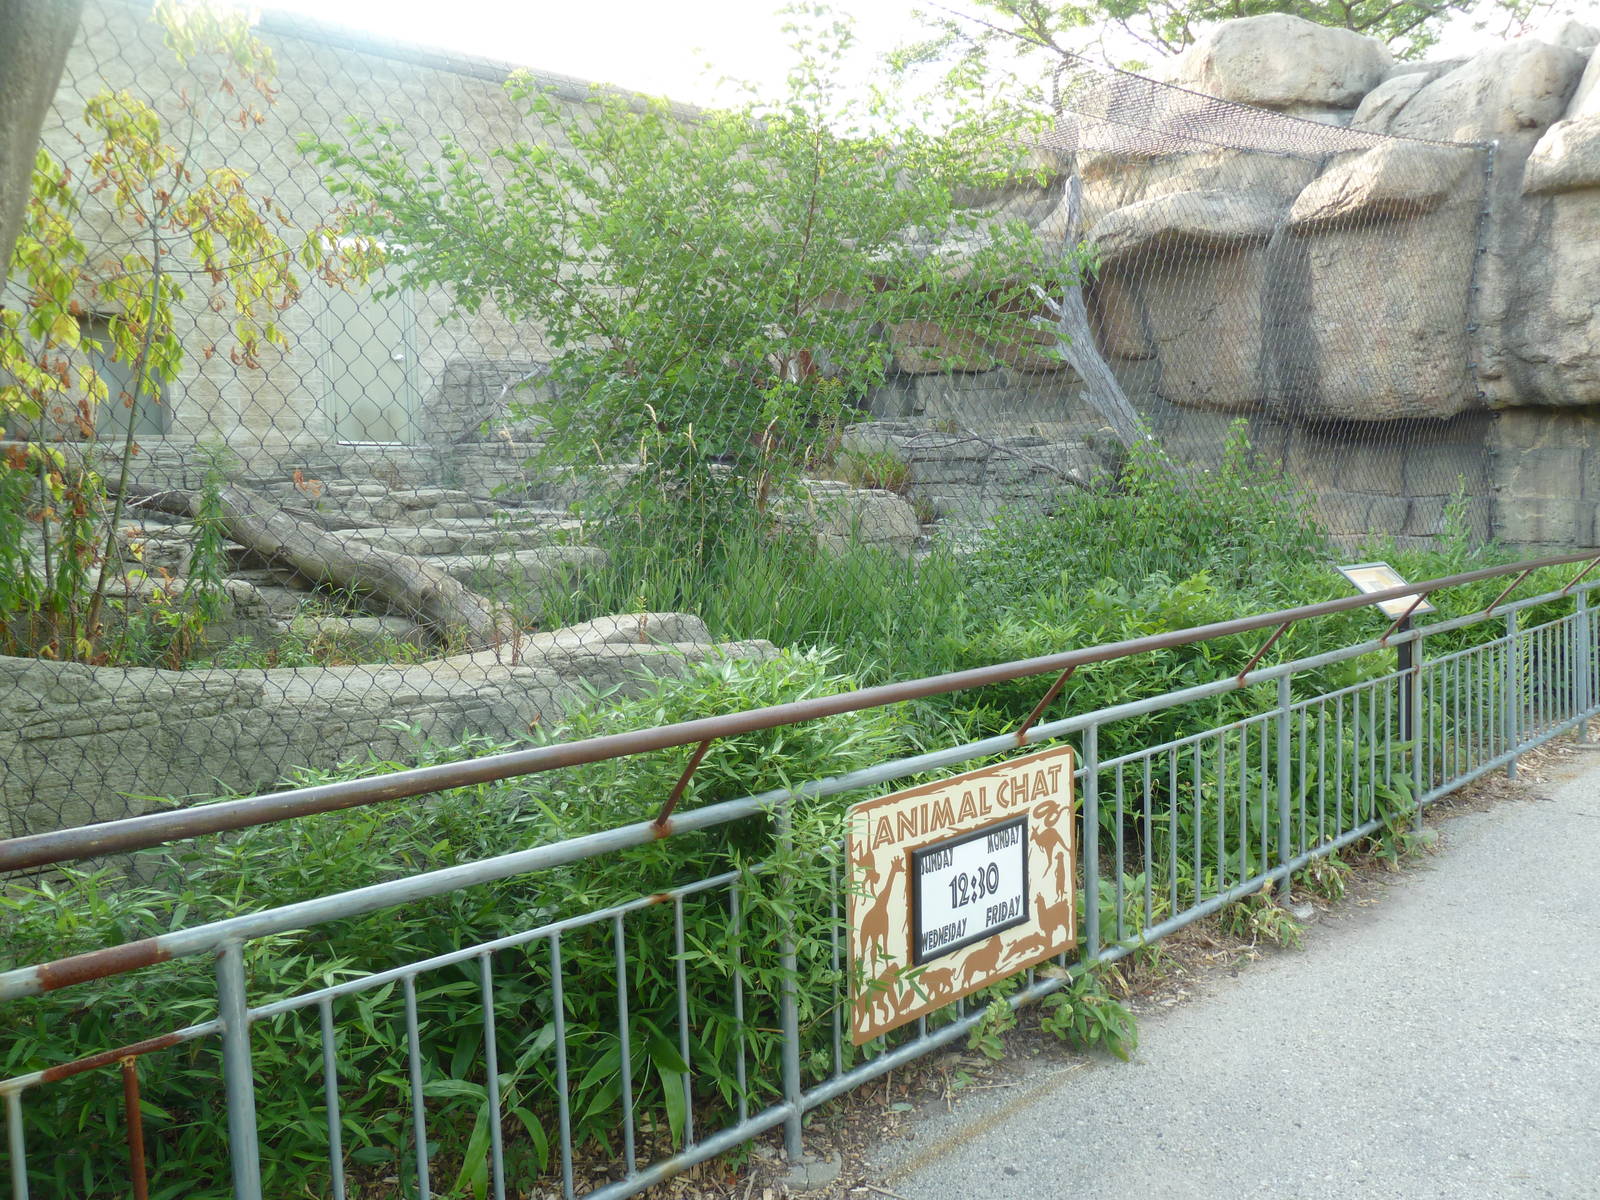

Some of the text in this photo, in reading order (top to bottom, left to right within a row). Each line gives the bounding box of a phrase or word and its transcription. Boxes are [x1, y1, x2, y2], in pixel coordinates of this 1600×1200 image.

[873, 764, 1062, 850] ANIMAL CHAT
[987, 826, 1020, 854] MONDAY
[949, 862, 999, 909] 12:30
[985, 895, 1020, 928] FRIDAY
[921, 918, 967, 952] WEDNESDAY
